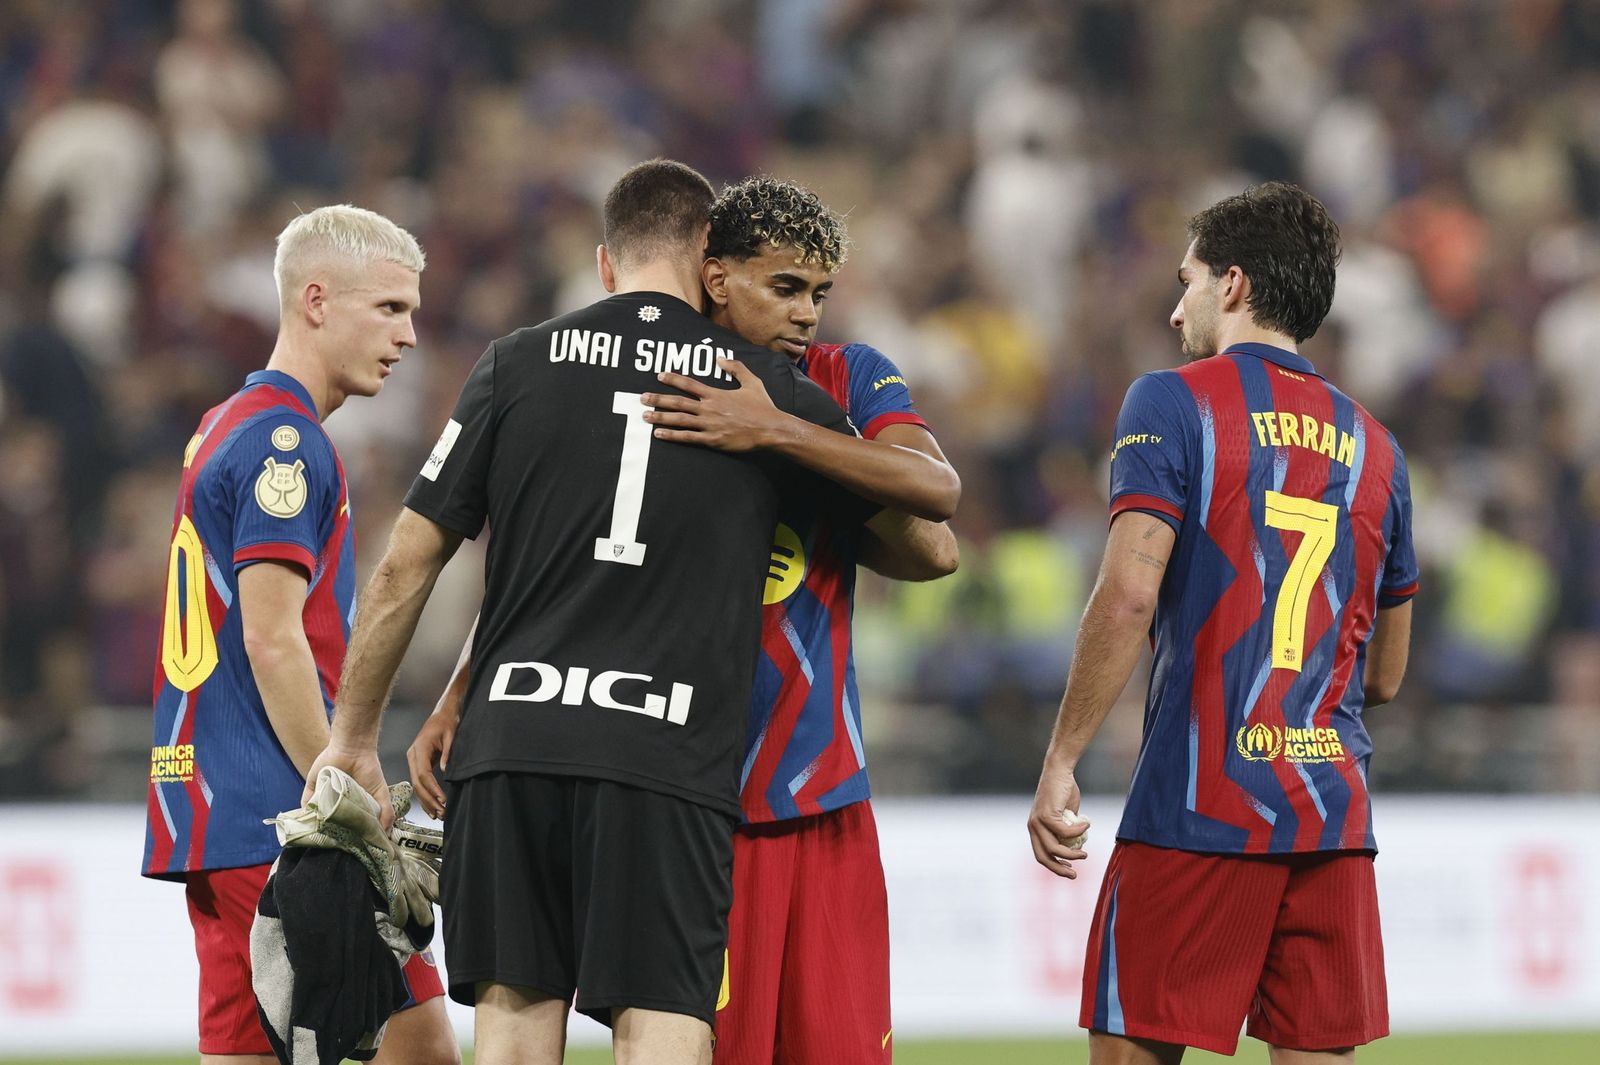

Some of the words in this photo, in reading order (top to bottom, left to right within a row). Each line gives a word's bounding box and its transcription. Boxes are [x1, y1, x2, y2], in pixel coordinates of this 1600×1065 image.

[550, 329, 622, 368] UNAI
[634, 337, 735, 382] SIMÓN
[279, 434, 293, 442] 15
[1150, 434, 1162, 444] tv
[1251, 411, 1357, 468] FERRAN
[594, 391, 656, 567] 1
[1264, 490, 1339, 673] 7
[488, 661, 694, 726] DIGI
[1285, 726, 1339, 742] UNHCR
[151, 744, 194, 761] UNHCR
[1284, 742, 1344, 757] ACNUR
[150, 760, 194, 776] ACNUR
